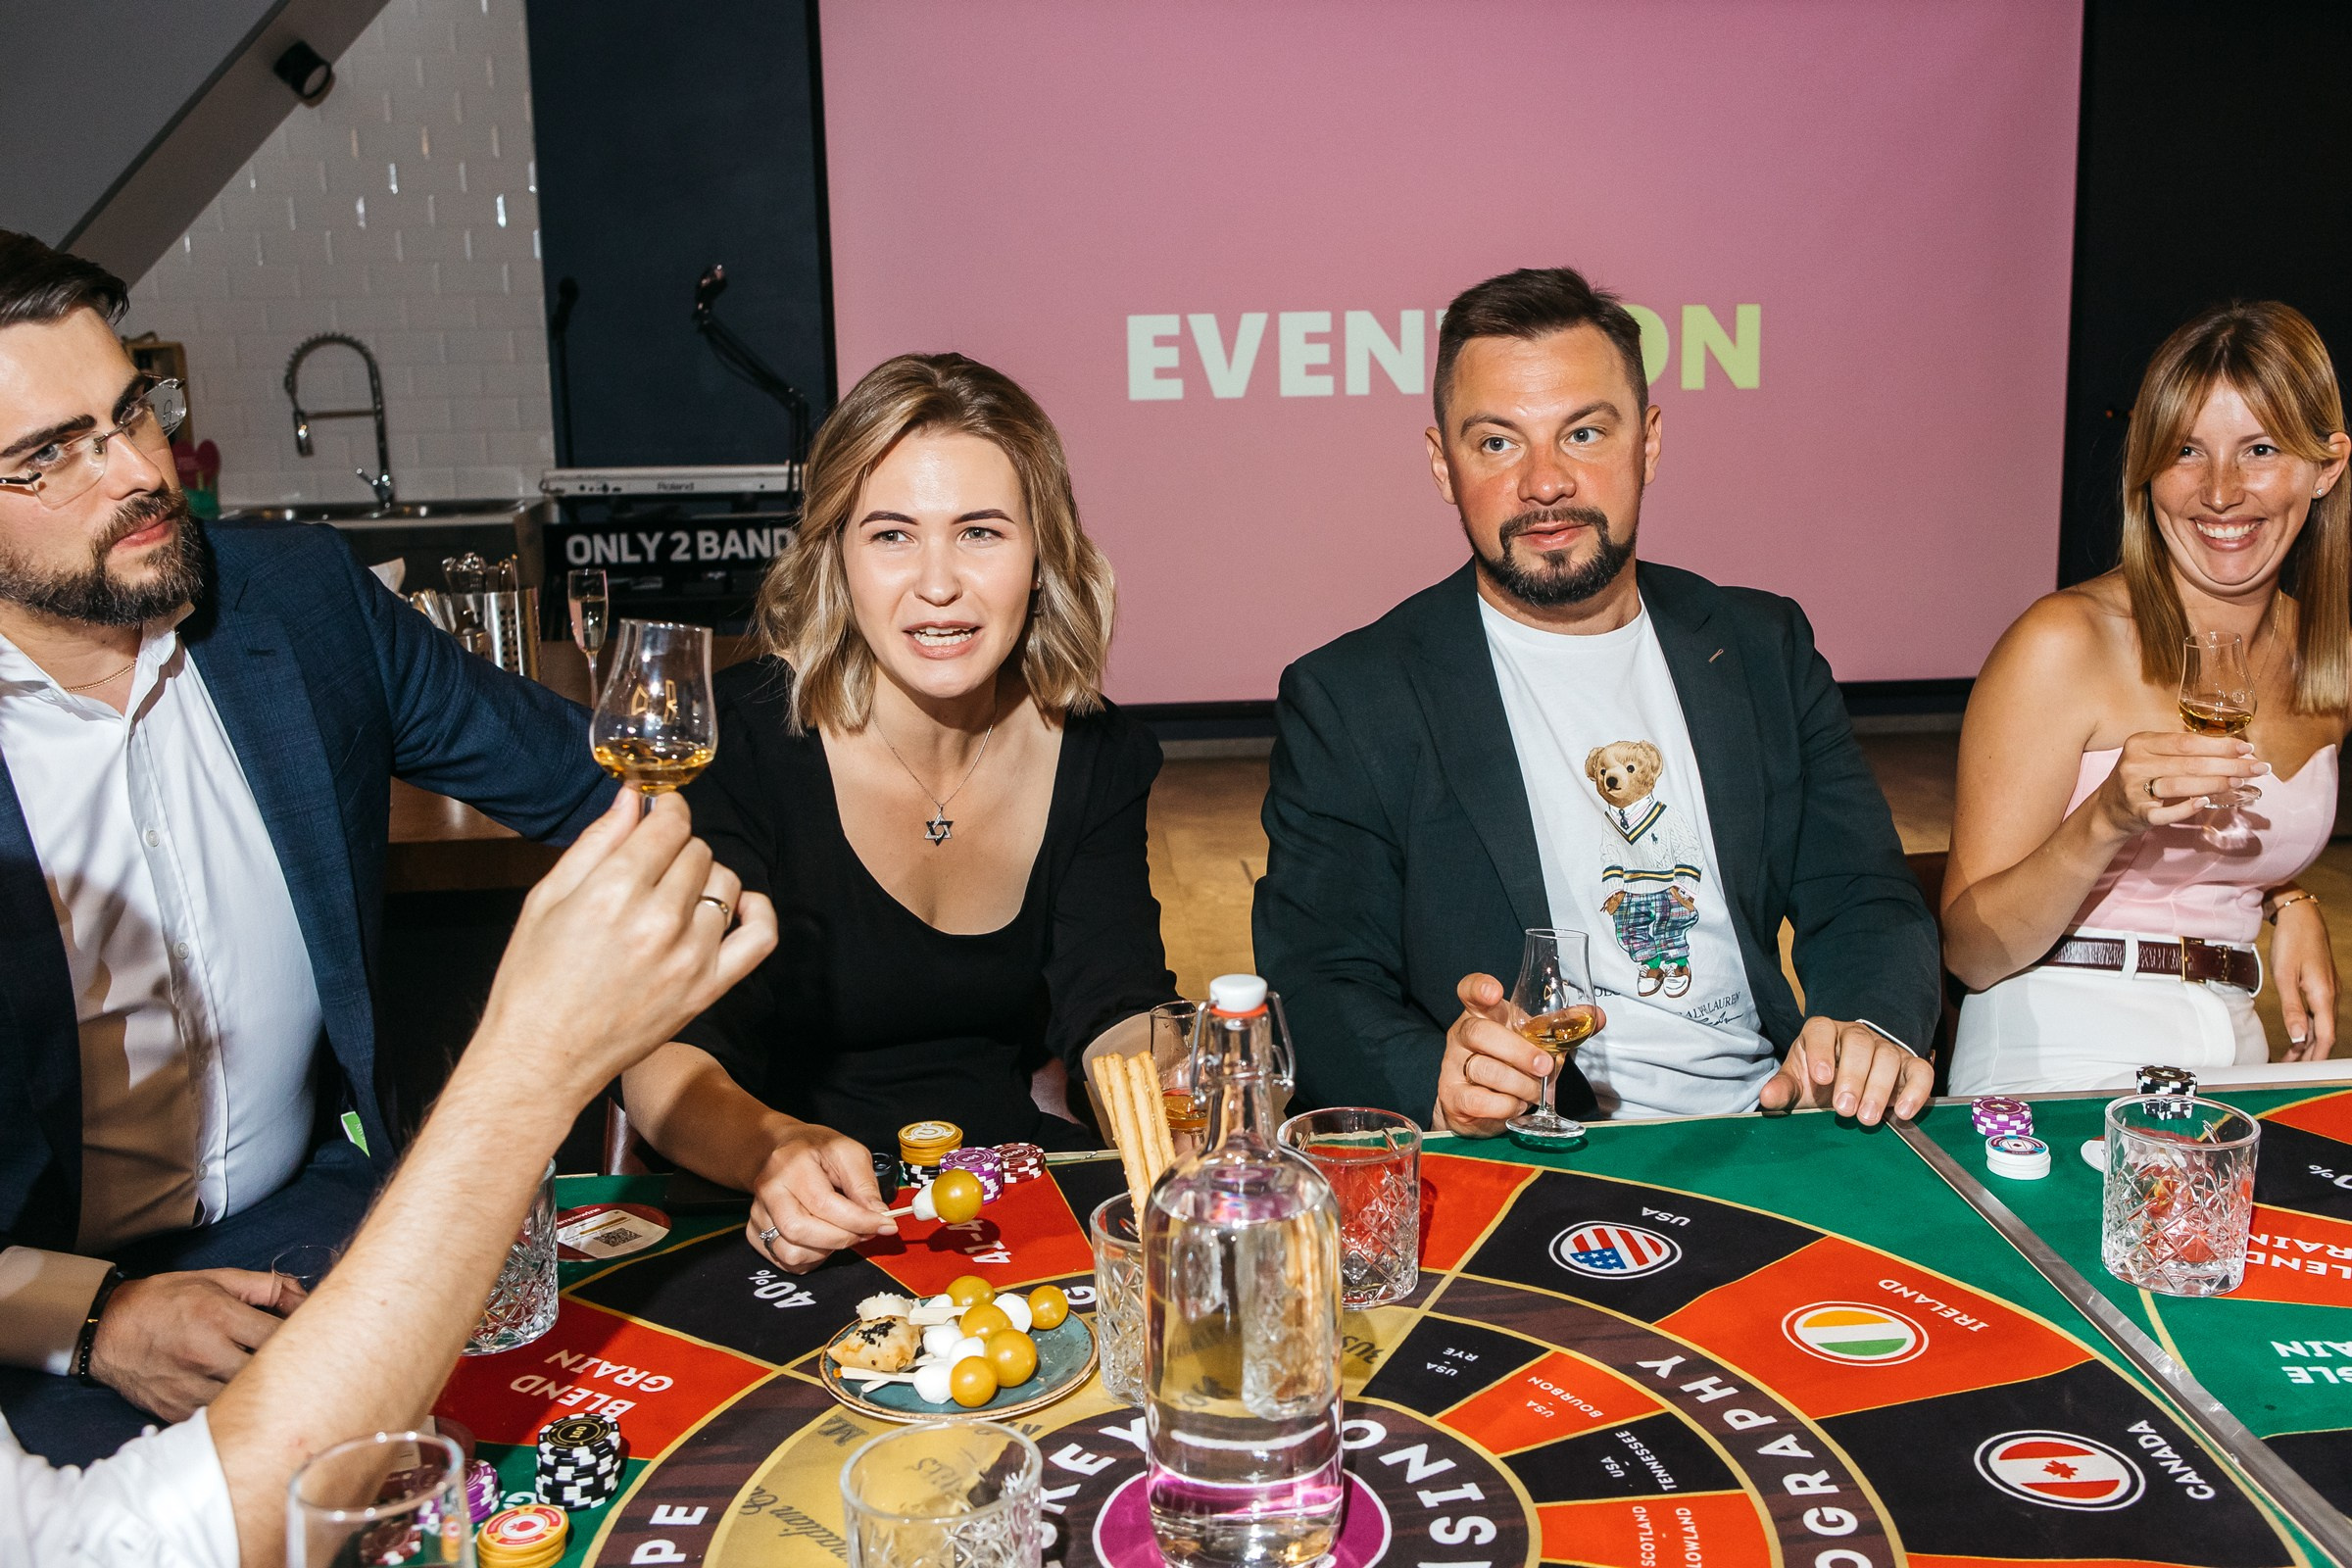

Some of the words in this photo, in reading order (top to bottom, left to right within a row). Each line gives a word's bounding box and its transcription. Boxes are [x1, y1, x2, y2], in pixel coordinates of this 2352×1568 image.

[565, 530, 664, 565] ONLY
[669, 531, 691, 562] 2
[1641, 1205, 1691, 1227] USA
[2245, 1250, 2352, 1280] LEND
[2247, 1233, 2352, 1260] RAIN
[748, 1269, 817, 1309] 40%
[1878, 1278, 1990, 1334] IRELAND
[1443, 1347, 1479, 1363] RYE
[2270, 1341, 2352, 1357] AIN
[544, 1348, 674, 1394] GRAIN
[1426, 1361, 1459, 1377] USA
[510, 1374, 637, 1418] BLEND
[1525, 1398, 1556, 1419] USA
[1527, 1376, 1604, 1419] BOURBON
[568, 1425, 588, 1439] 100
[1600, 1455, 1626, 1478] USA
[1614, 1430, 1678, 1492] TENNESSEE
[1637, 1355, 1873, 1568] OGRAPHY
[2127, 1419, 2216, 1501] CANADA
[1632, 1505, 1656, 1567] SCOTLAND
[1676, 1507, 1702, 1568] LOWLAND
